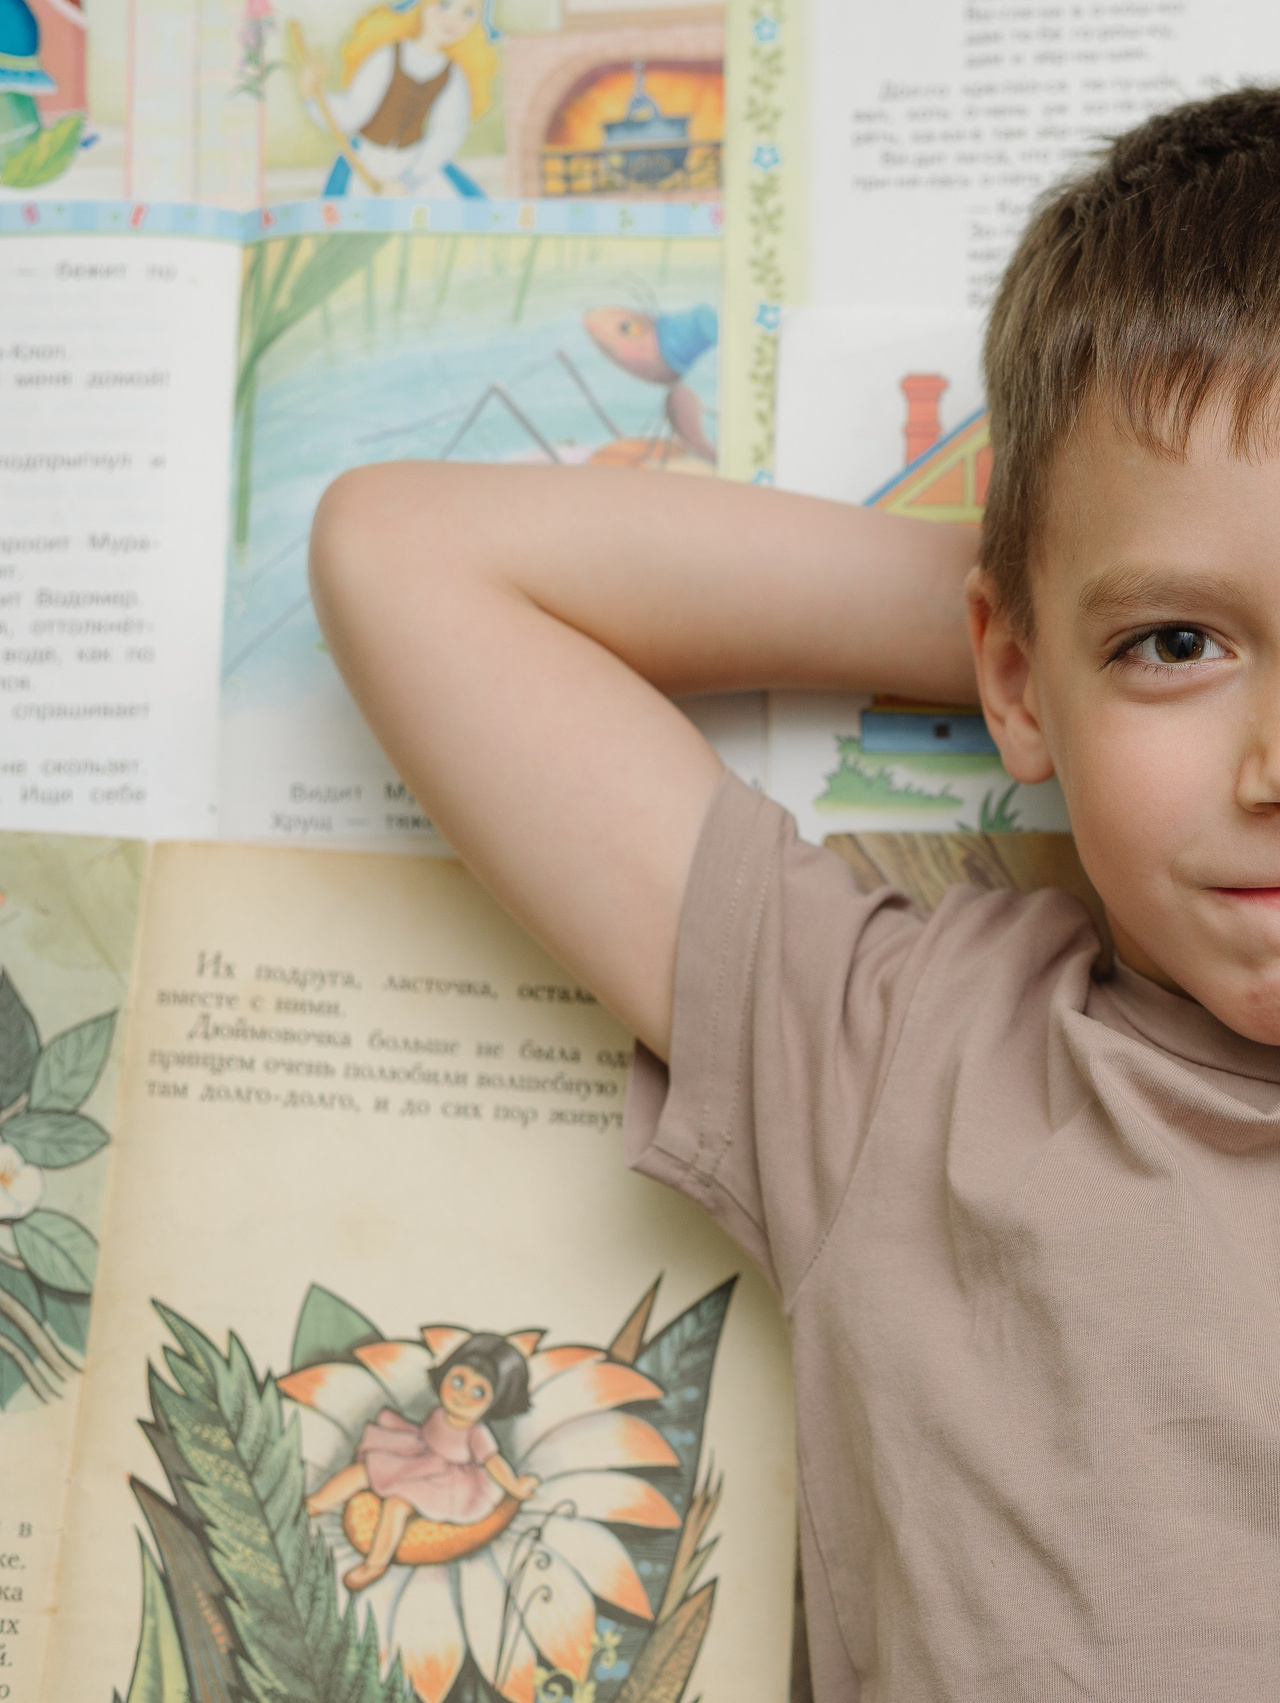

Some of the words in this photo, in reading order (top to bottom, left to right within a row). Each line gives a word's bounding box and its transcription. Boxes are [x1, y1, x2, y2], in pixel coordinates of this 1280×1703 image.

[197, 950, 236, 979] Их
[254, 964, 362, 991] подруга,
[384, 974, 498, 999] ласточка,
[156, 988, 239, 1010] вместе
[249, 996, 265, 1013] с
[274, 997, 346, 1019] ними.
[186, 1011, 352, 1048] Дюймовочка
[367, 1028, 460, 1057] больше
[475, 1042, 503, 1059] не
[519, 1038, 581, 1063] была
[263, 1058, 336, 1078] очень
[343, 1061, 468, 1088] полюбили
[476, 1072, 618, 1101] волшебную
[146, 1081, 189, 1099] там
[199, 1083, 361, 1114] долго-долго,
[373, 1096, 390, 1113] и
[400, 1098, 431, 1117] до
[440, 1101, 482, 1119] сих
[493, 1105, 538, 1130] пор
